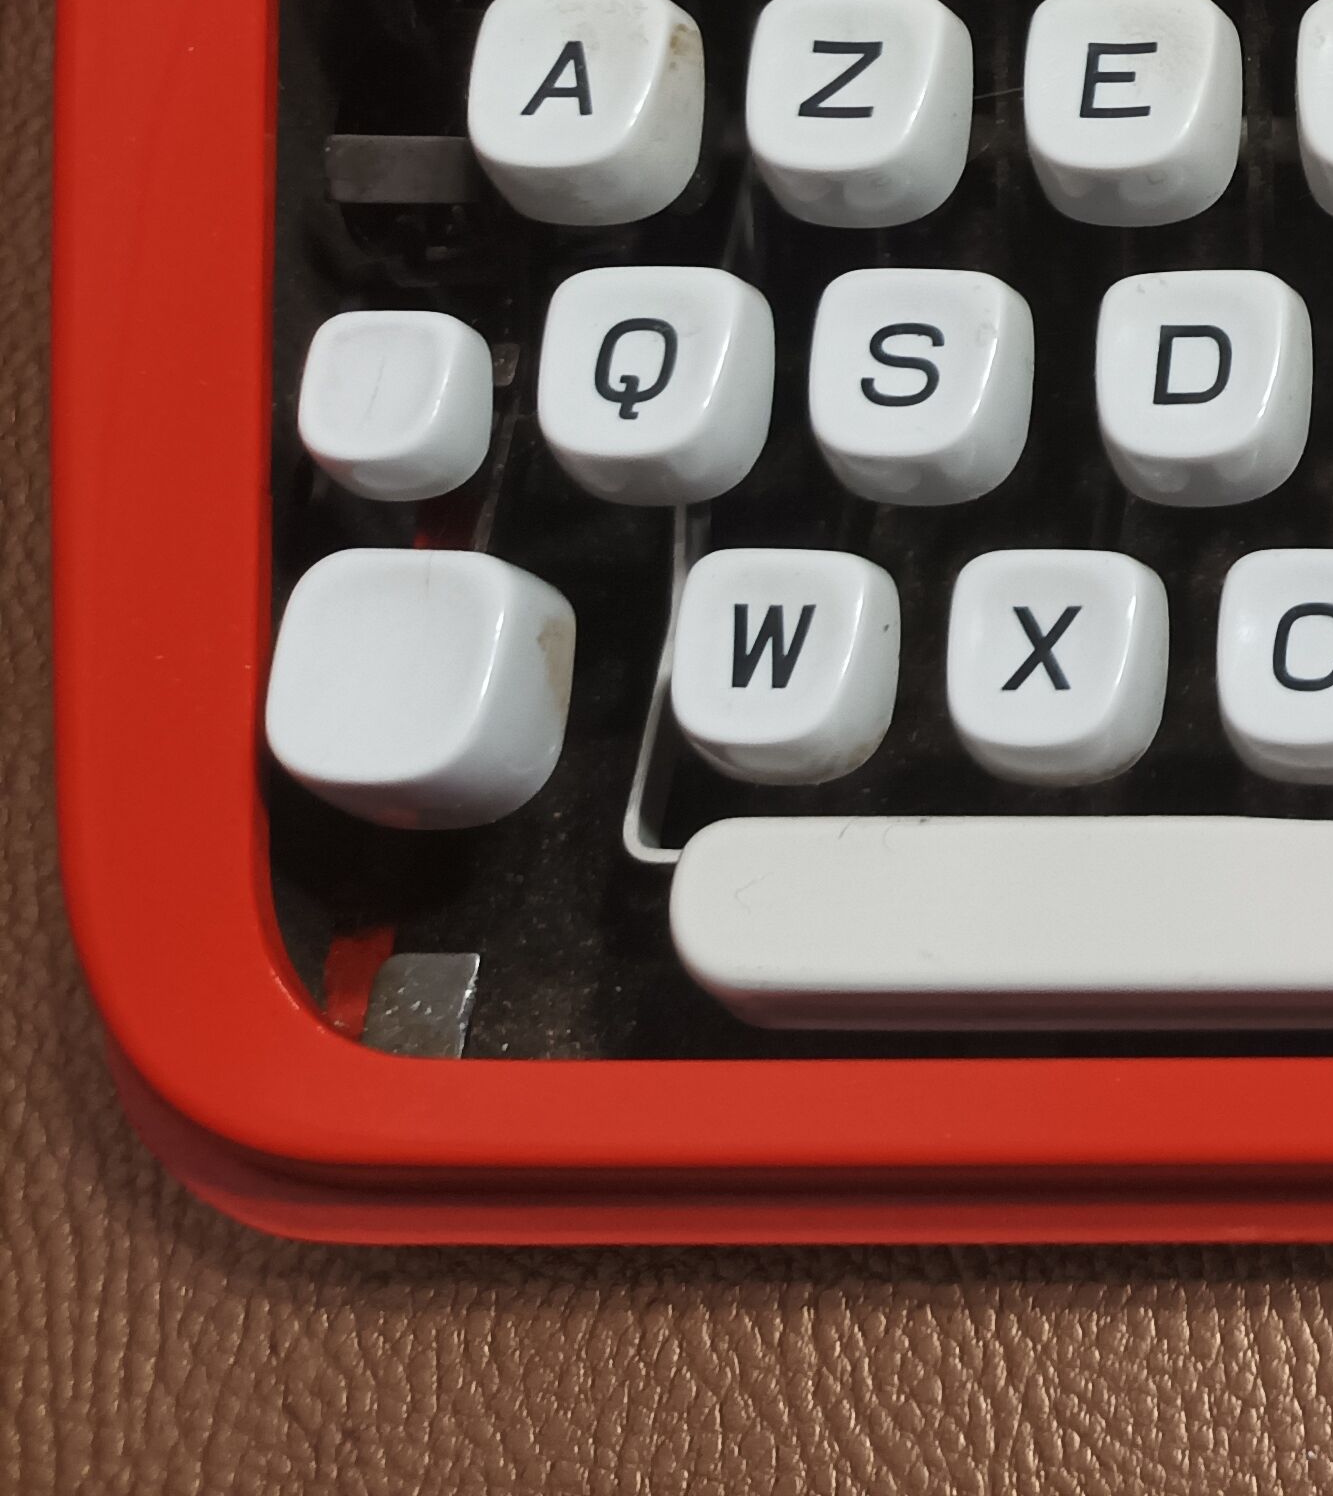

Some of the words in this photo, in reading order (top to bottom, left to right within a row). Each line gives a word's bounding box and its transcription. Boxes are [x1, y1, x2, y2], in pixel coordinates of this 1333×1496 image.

[521, 41, 592, 115] A
[798, 40, 882, 118] Z
[1080, 42, 1157, 118] E
[595, 318, 677, 419] Q
[861, 323, 944, 407] S
[1153, 325, 1232, 405] D
[732, 604, 816, 688] W
[1002, 606, 1081, 691] X
